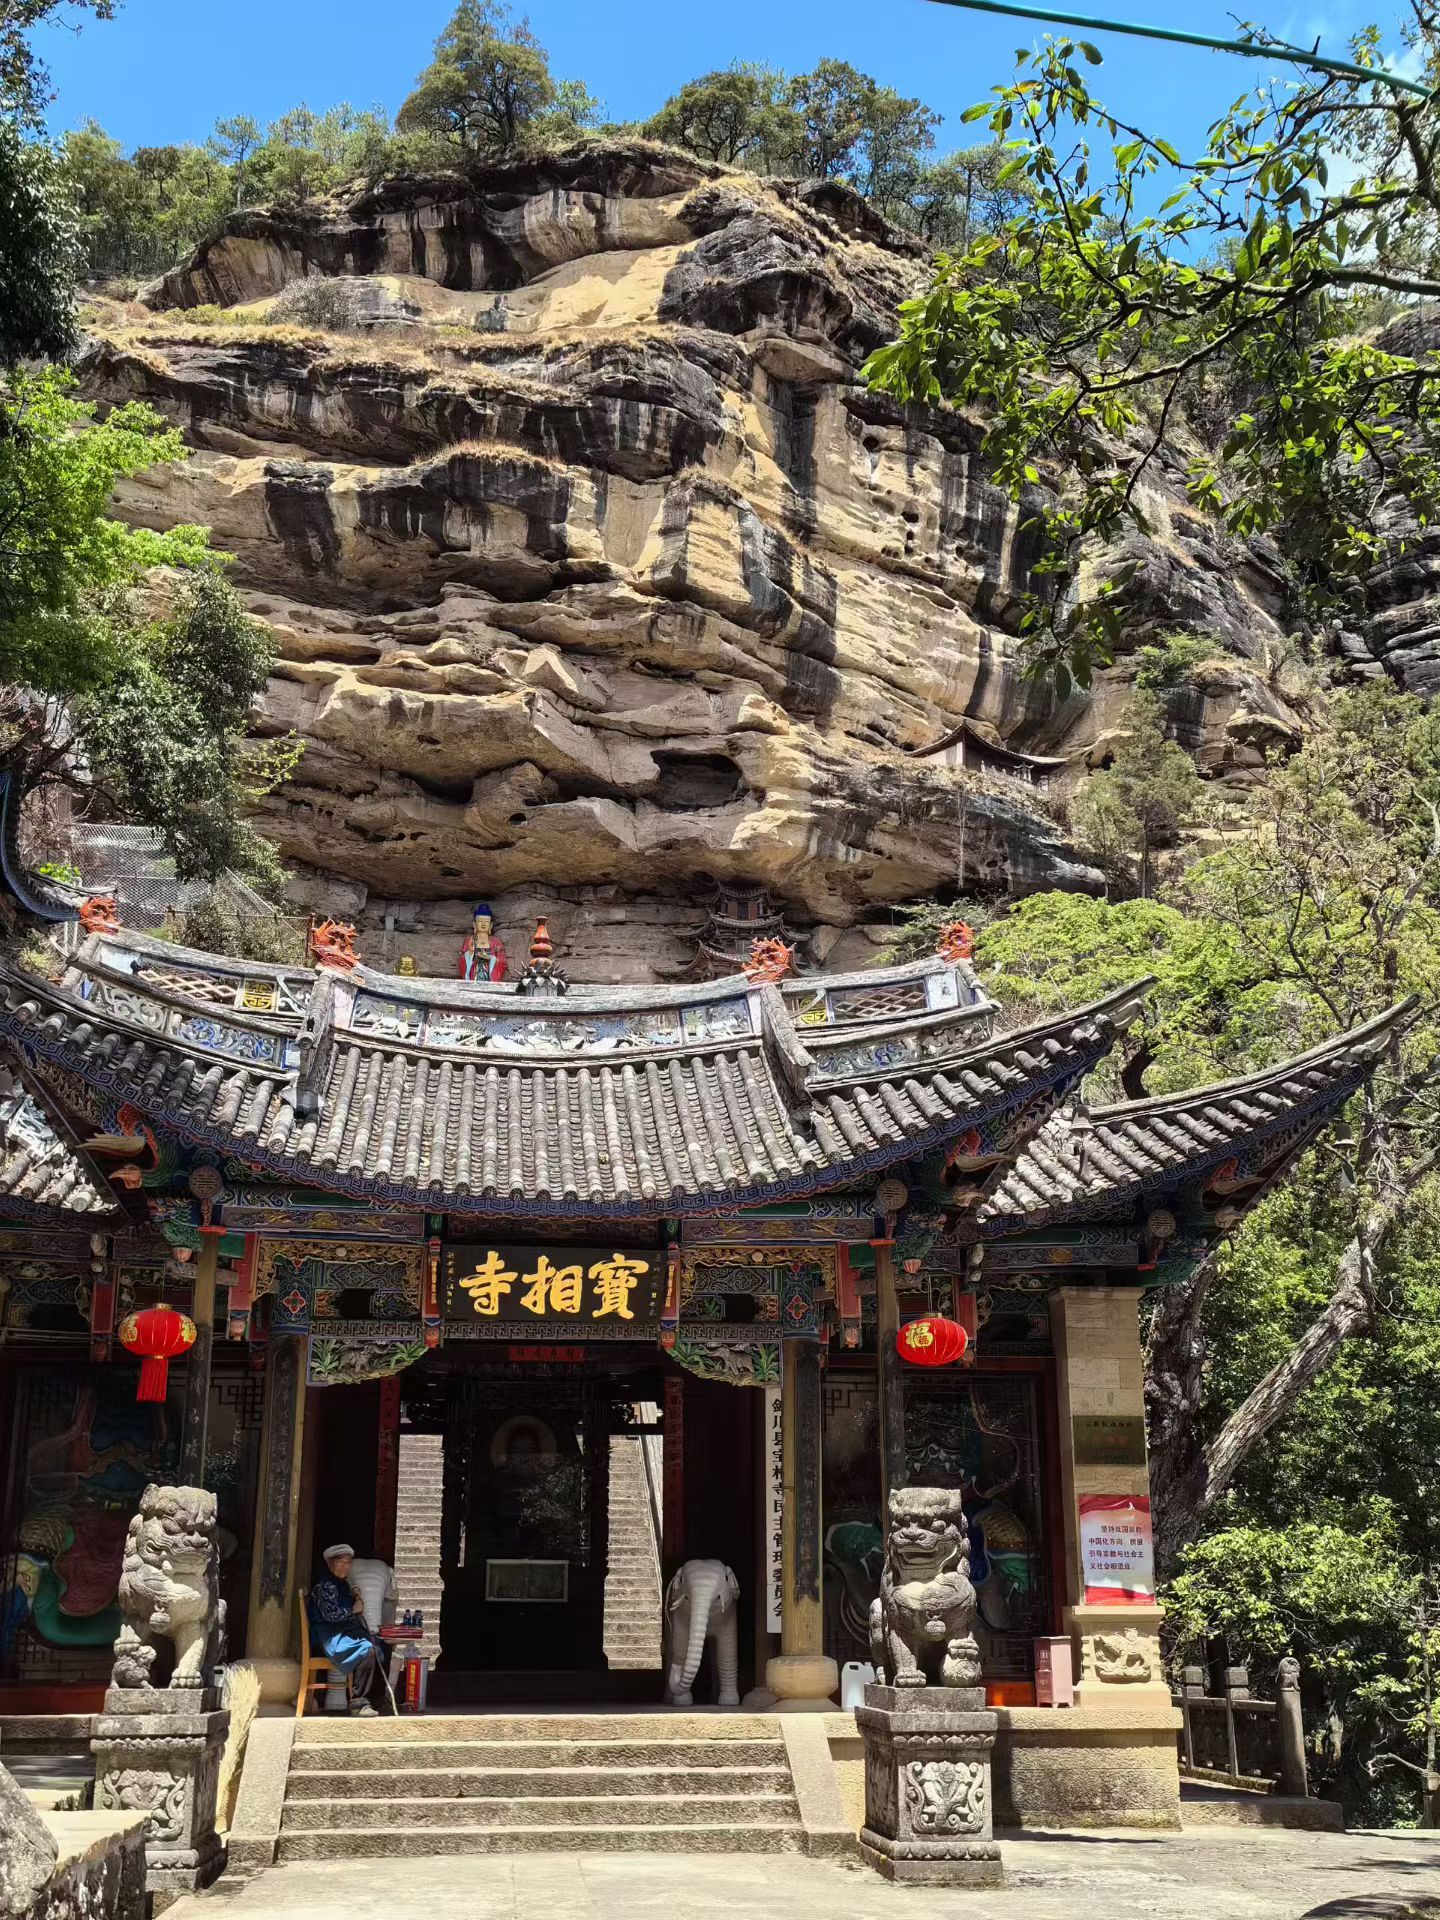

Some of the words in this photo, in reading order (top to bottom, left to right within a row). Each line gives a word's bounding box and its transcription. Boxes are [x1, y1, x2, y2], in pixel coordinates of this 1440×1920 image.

[458, 1250, 649, 1319] 寶相寺
[905, 1322, 933, 1348] 福
